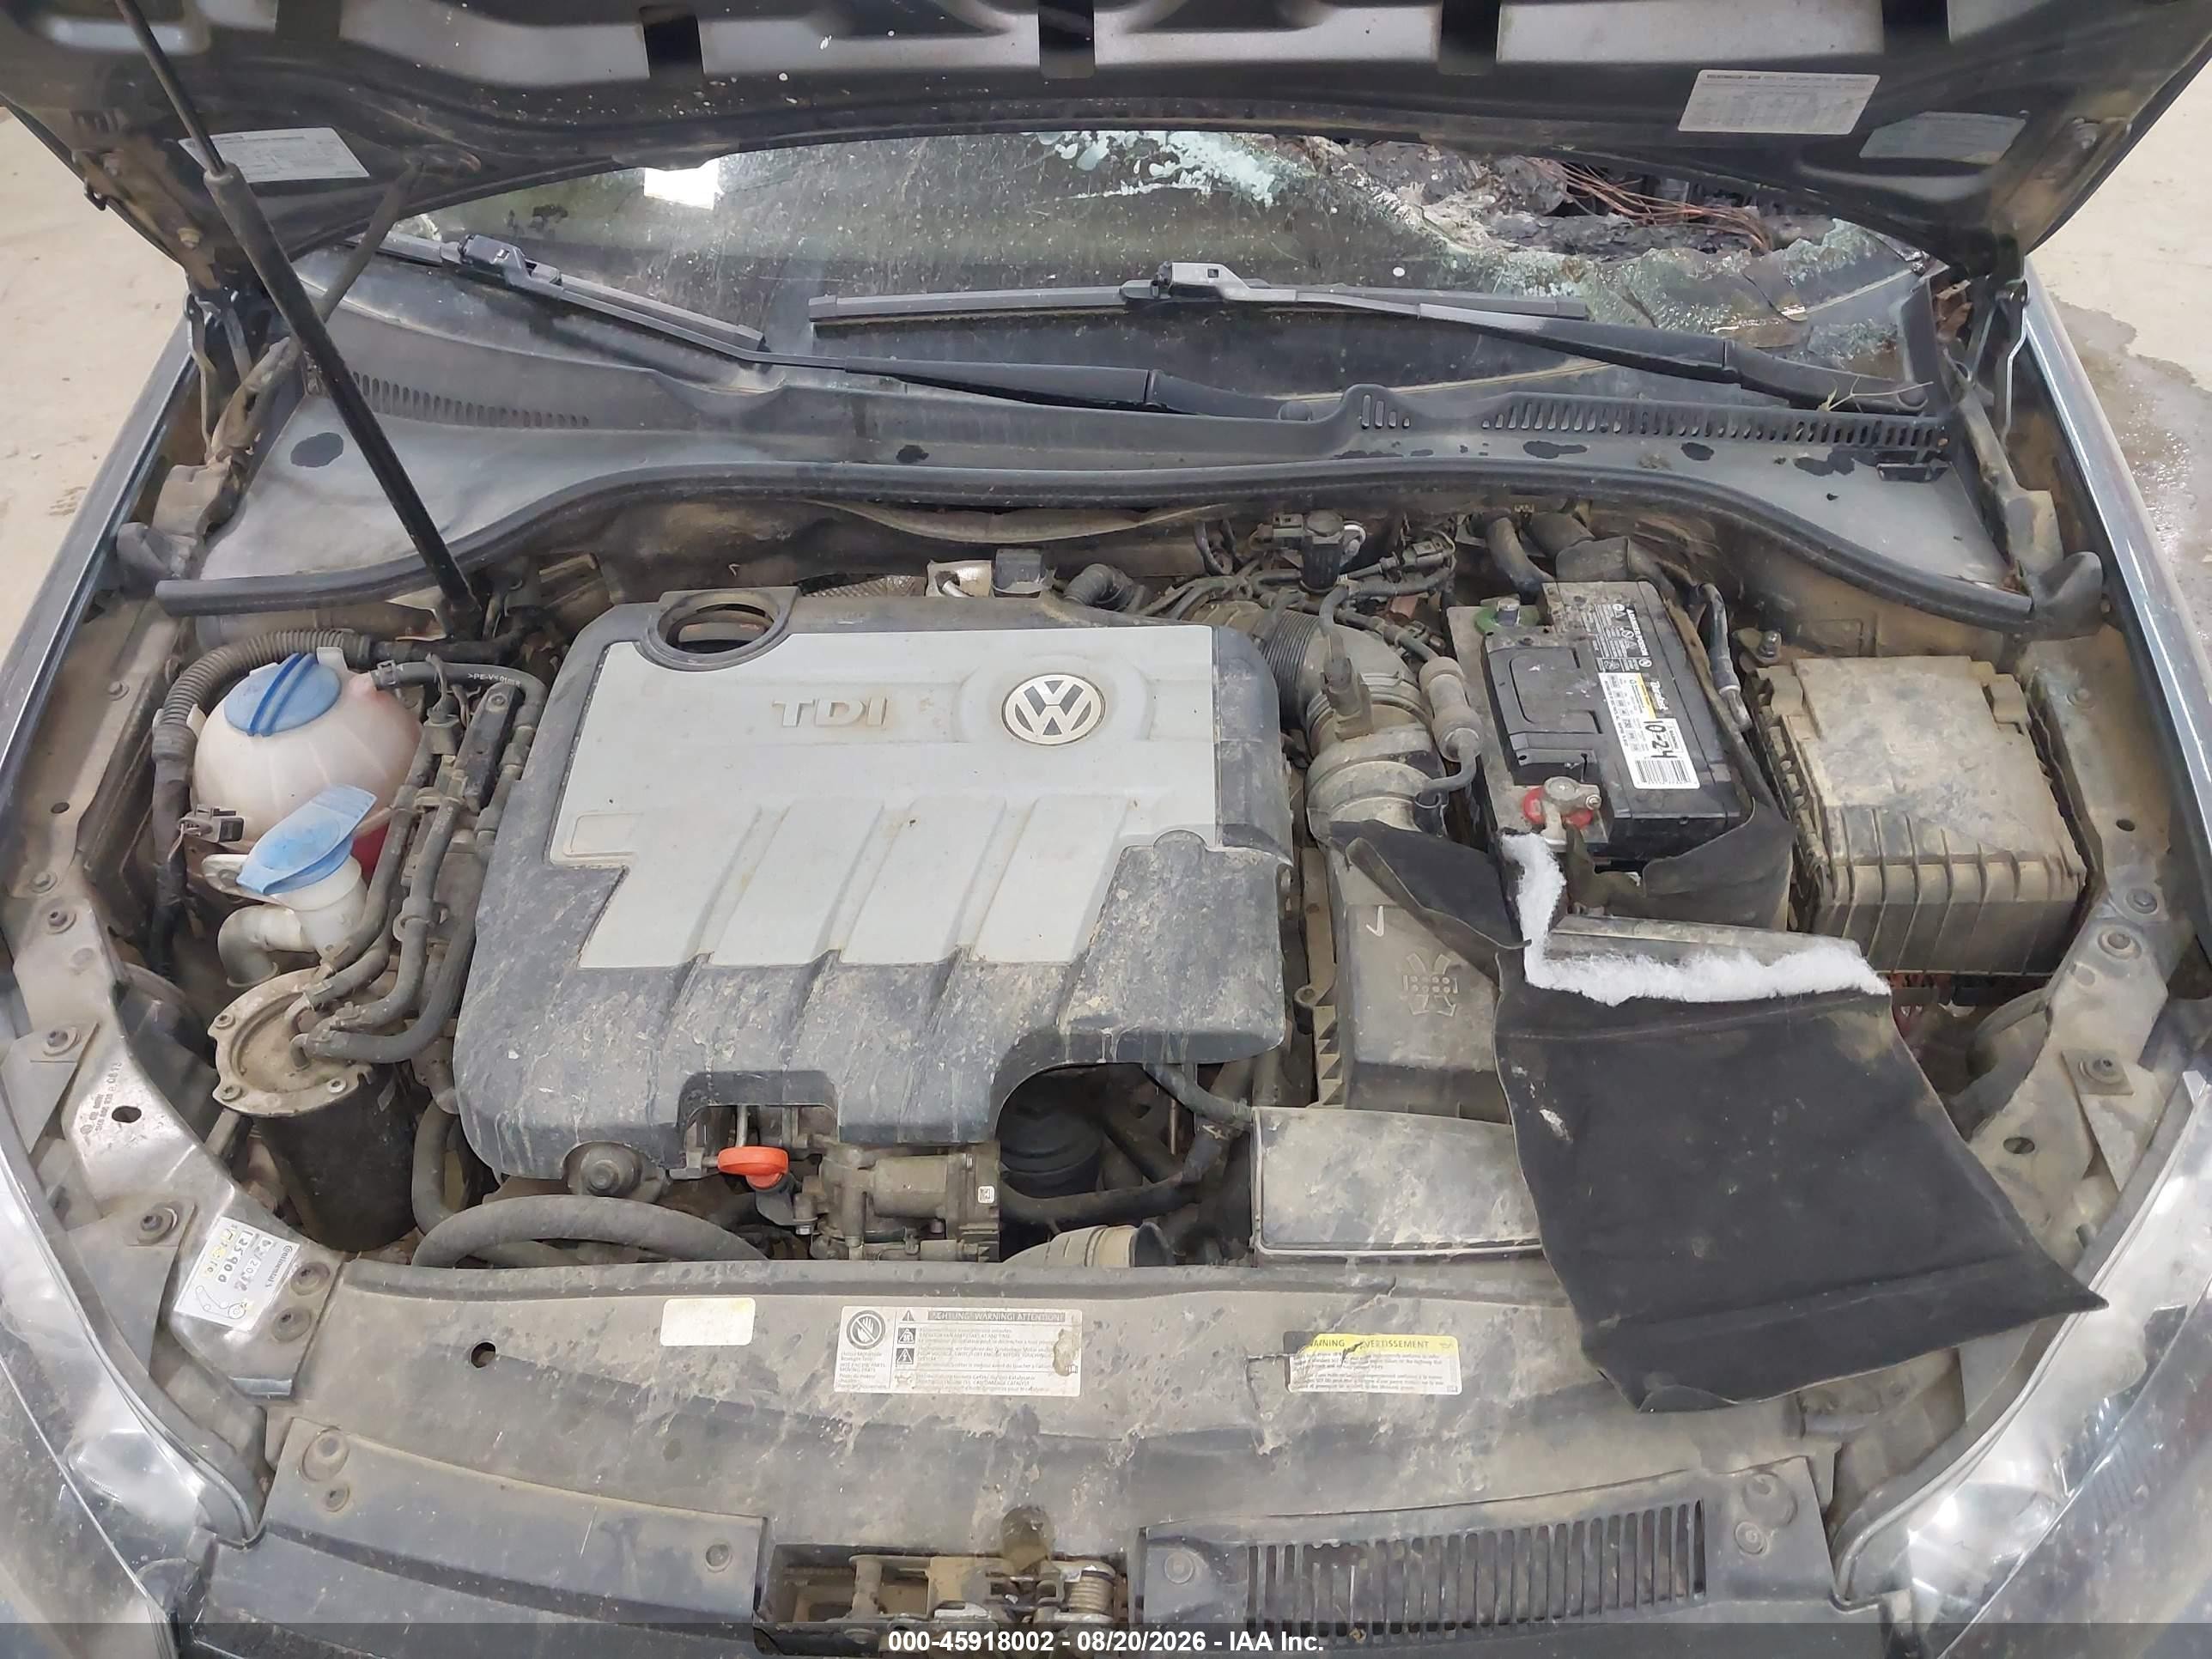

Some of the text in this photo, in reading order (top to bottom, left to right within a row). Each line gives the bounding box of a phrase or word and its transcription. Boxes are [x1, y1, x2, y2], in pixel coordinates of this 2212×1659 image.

[774, 698, 888, 728] TDI
[1644, 720, 1678, 759] 10-24
[1310, 1339, 1345, 1347] ARNING
